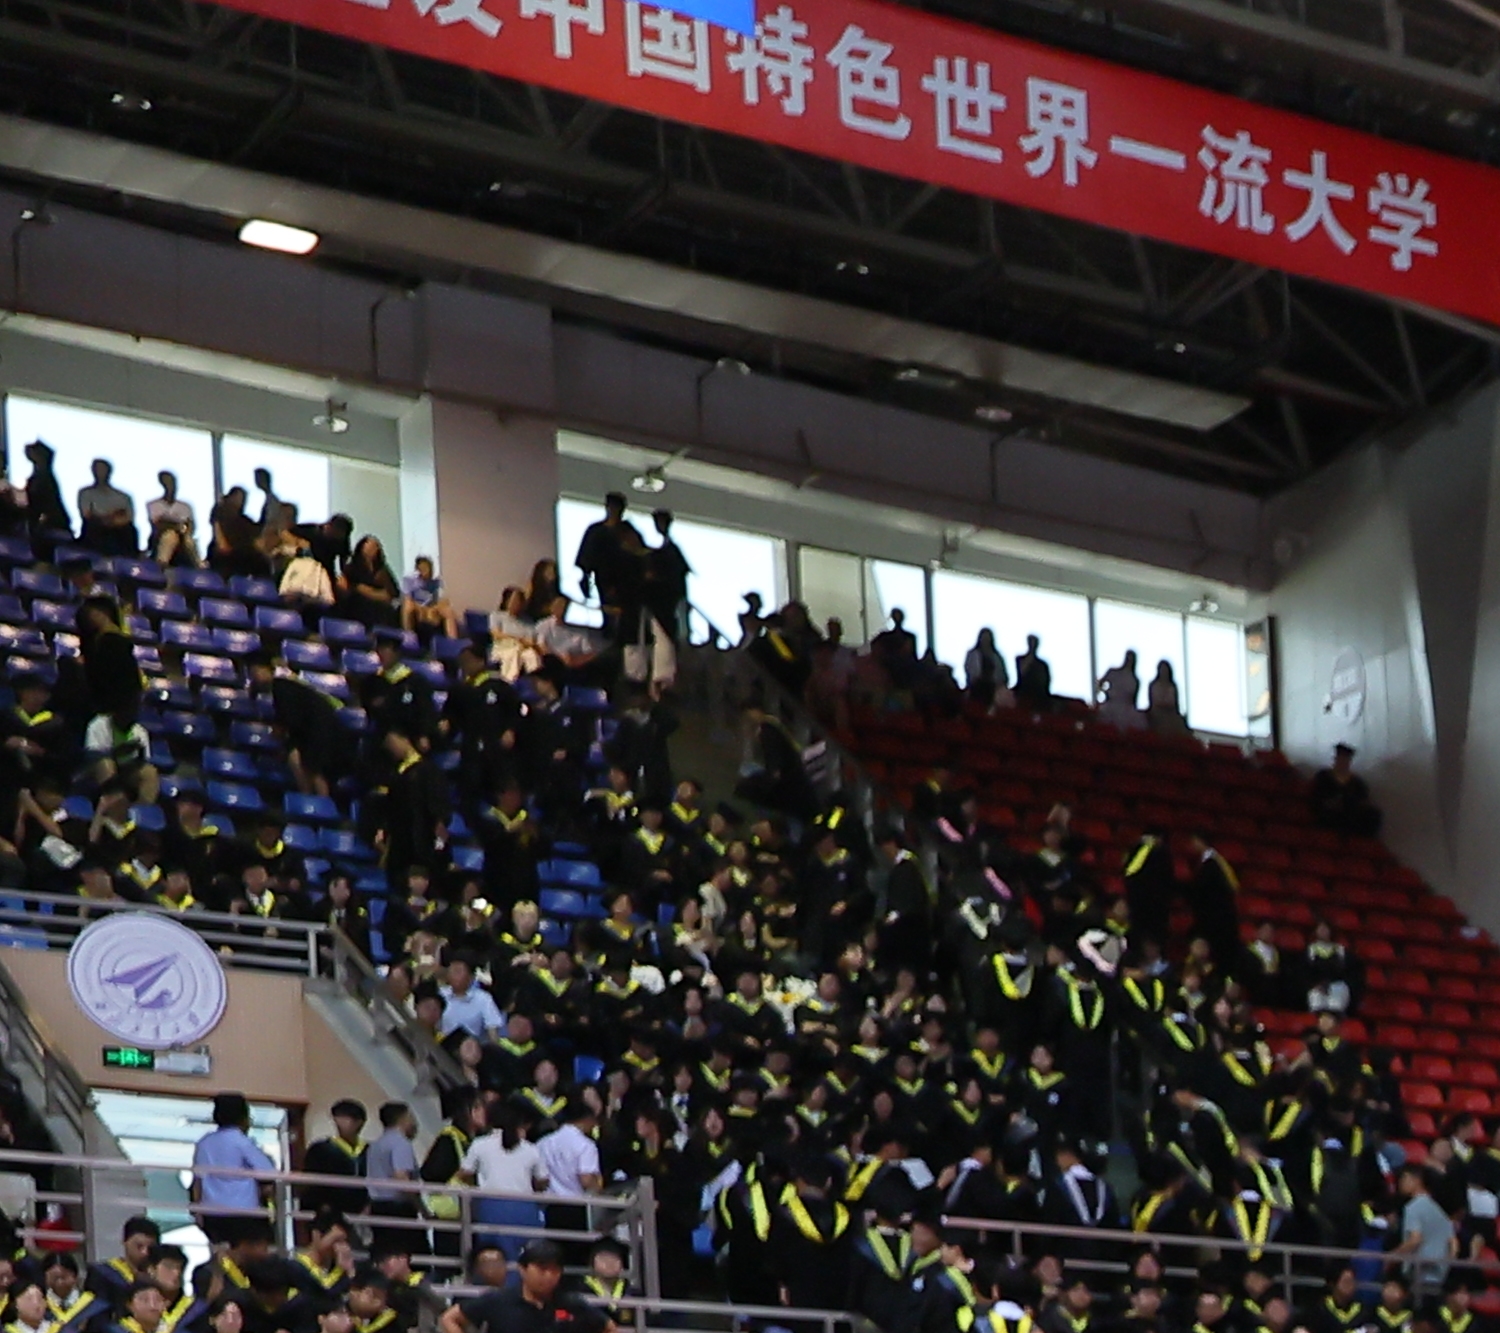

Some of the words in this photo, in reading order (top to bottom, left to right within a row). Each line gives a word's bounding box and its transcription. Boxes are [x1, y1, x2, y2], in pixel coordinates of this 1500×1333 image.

[350, 0, 1441, 273] 中国特色世界一流大学
